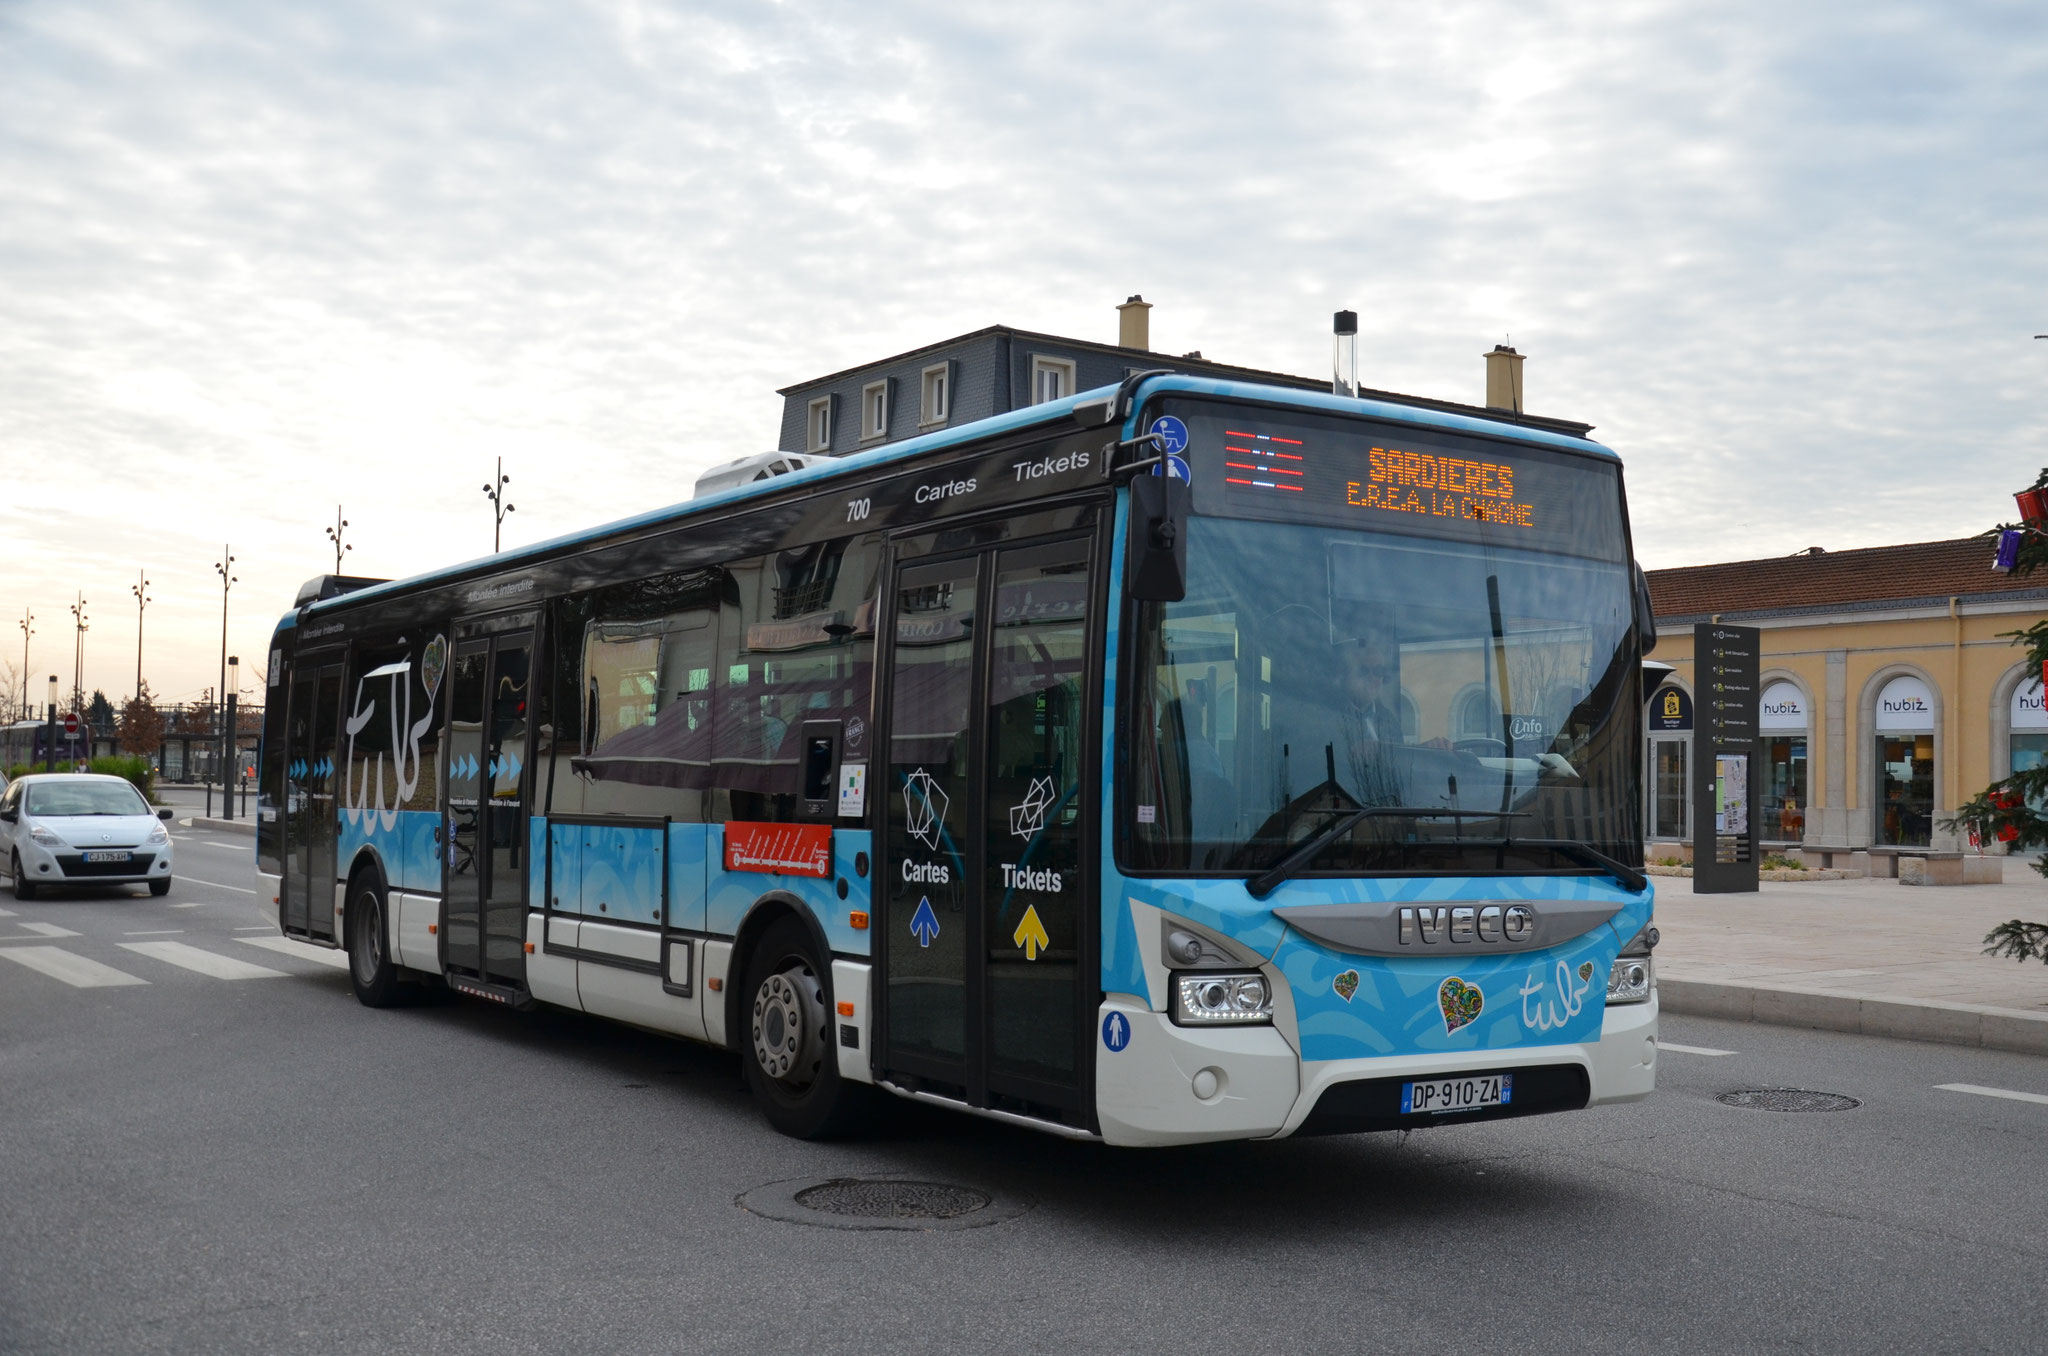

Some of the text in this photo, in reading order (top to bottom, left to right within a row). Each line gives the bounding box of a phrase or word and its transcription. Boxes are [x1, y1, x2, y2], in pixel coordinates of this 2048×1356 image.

[1012, 450, 1090, 482] Tickets
[1369, 447, 1513, 498] SARDIERES
[914, 477, 977, 504] Cartes
[1348, 481, 1533, 527] E.R.E.A. LA CHAGNE
[846, 497, 871, 522] 700
[467, 580, 535, 603] Montée interdite
[1764, 701, 1800, 714] hubiz
[1884, 697, 1928, 711] hubiz
[902, 858, 949, 884] Cartes
[1001, 863, 1062, 893] Tickets
[1399, 905, 1533, 946] IVECO
[1519, 960, 1590, 1031] tub
[1413, 1079, 1500, 1109] DP-910-ZA
[1502, 1090, 1510, 1101] 01
